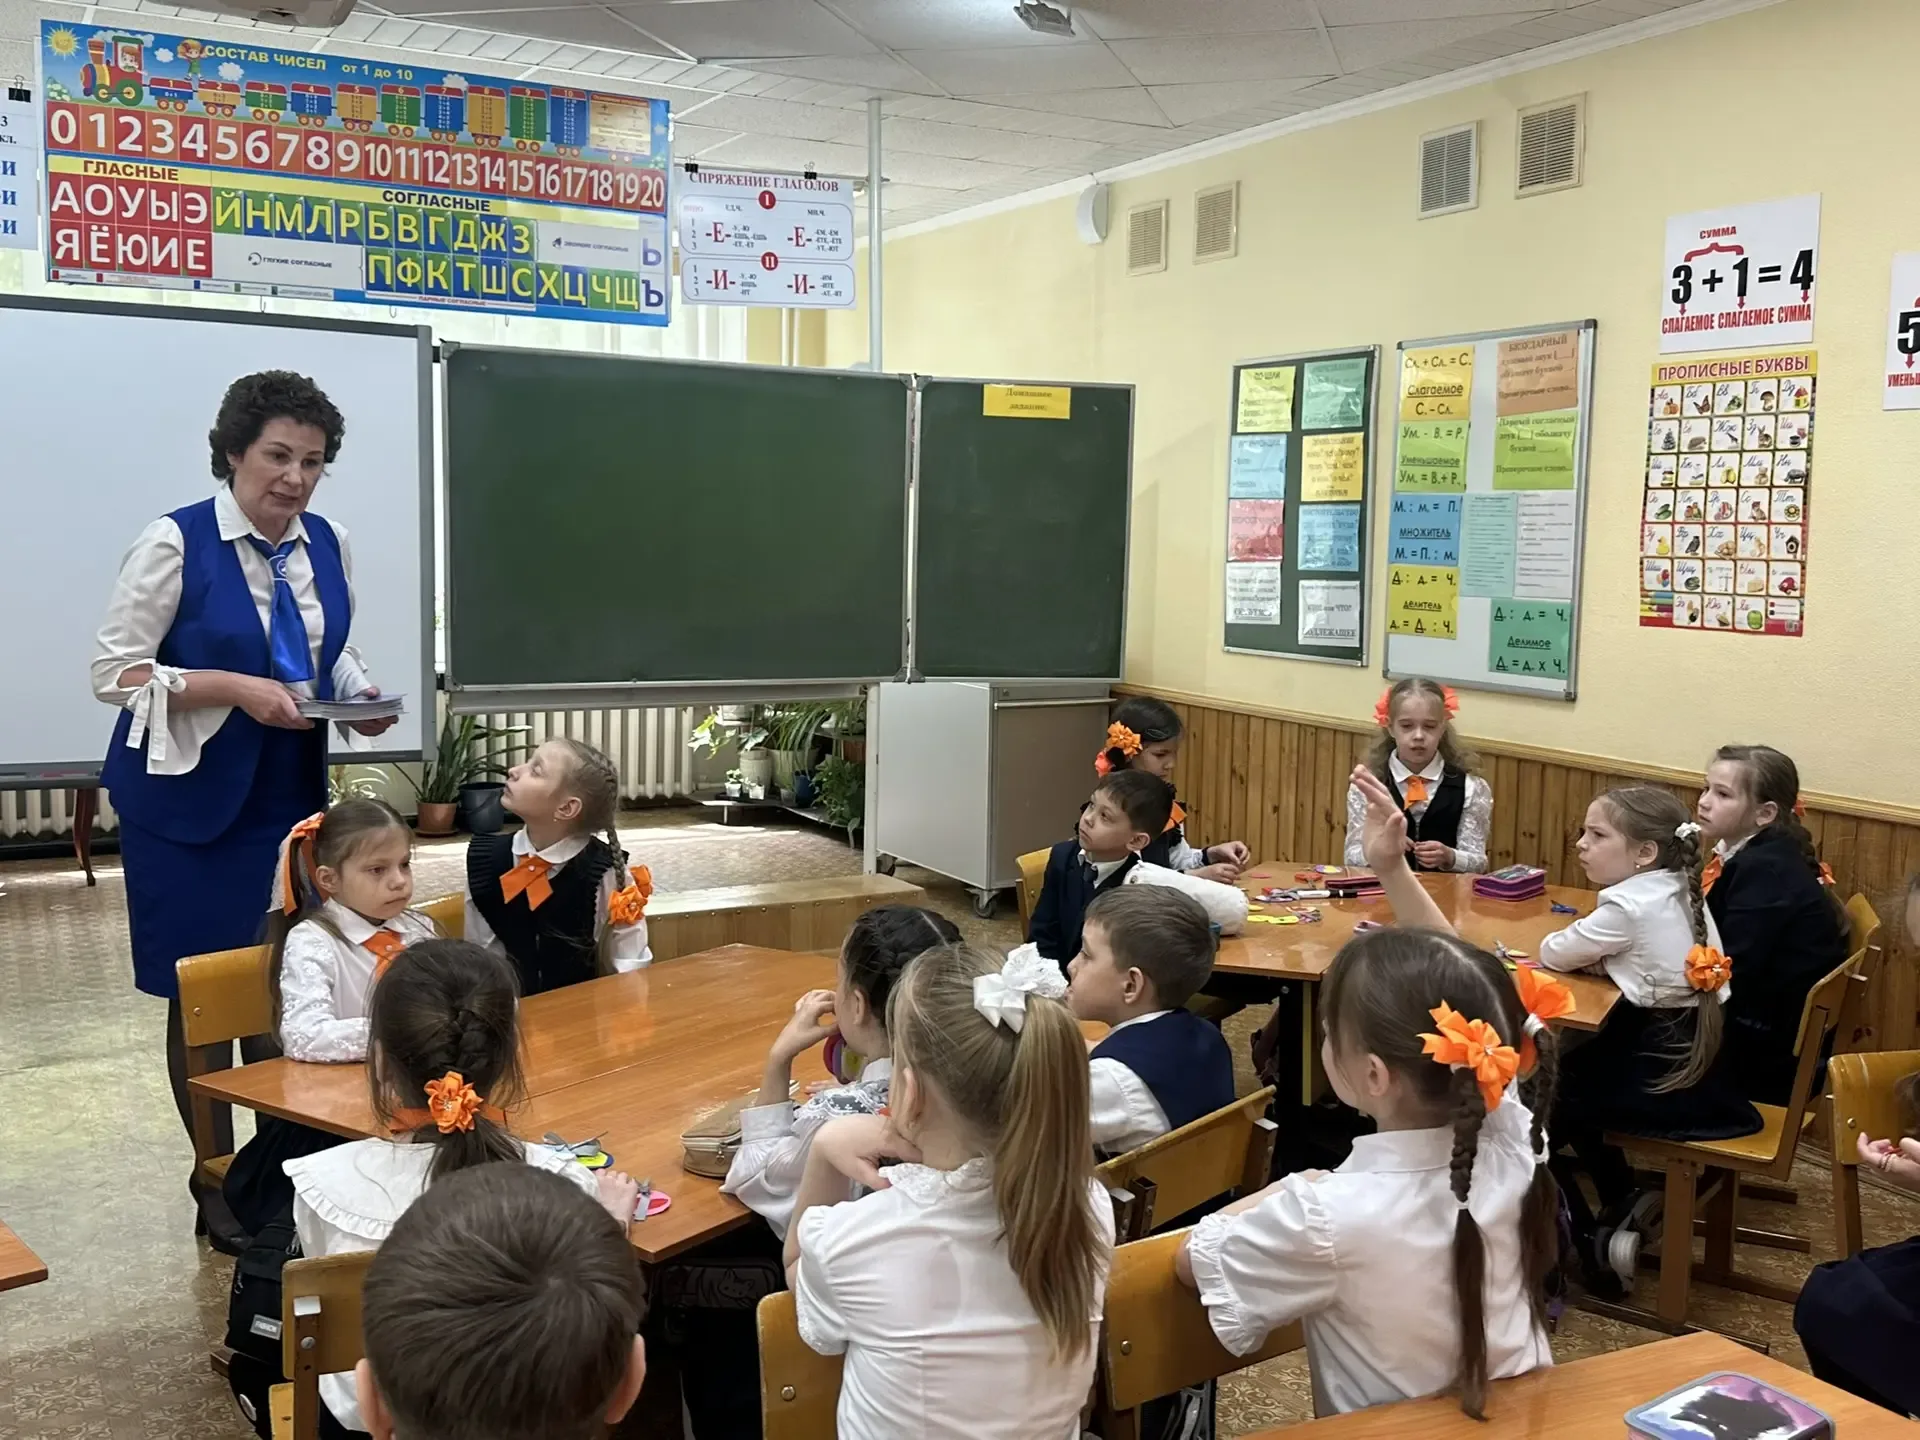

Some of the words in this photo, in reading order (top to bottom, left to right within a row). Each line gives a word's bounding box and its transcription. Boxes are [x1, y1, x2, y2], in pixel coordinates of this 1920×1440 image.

[204, 45, 269, 64] СОСТАВ
[274, 54, 326, 71] ЧИСЕЛ
[341, 65, 357, 74] от
[362, 65, 369, 76] 1
[374, 69, 392, 79] до
[396, 69, 413, 81] 10
[50, 109, 77, 144] 0
[89, 113, 105, 148] 1
[118, 115, 143, 151] 2
[151, 119, 175, 154] 3
[181, 124, 208, 158] 4
[215, 127, 237, 160] 5
[245, 130, 270, 164] 6
[276, 133, 299, 167] 7
[306, 136, 331, 170] 8
[336, 139, 360, 172] 9
[365, 143, 392, 176] 10
[395, 147, 420, 180] 11
[423, 150, 450, 184] 12
[452, 153, 478, 187] 13
[480, 156, 506, 190] 14
[508, 160, 534, 193] 15
[536, 163, 560, 195] 16
[562, 166, 588, 198] 17
[589, 169, 613, 201] 18
[616, 173, 638, 204] 19
[640, 176, 665, 208] 20
[83, 160, 179, 181] ГЛАСНЫЕ
[689, 172, 771, 188] СПРЯЖЕНИЕ
[774, 178, 839, 192] ГЛАГОЛОВ
[382, 190, 491, 212] СОГЛАСНЫЕ
[51, 181, 82, 214] А
[84, 183, 113, 216] О
[117, 186, 145, 218] У
[151, 190, 178, 222] Ы
[184, 192, 207, 224] Э
[215, 191, 241, 228] Й
[245, 199, 270, 231] Н
[275, 205, 301, 233] М
[306, 206, 331, 235] Л
[341, 208, 360, 236] Р
[368, 211, 390, 240] Б
[398, 212, 419, 243] В
[429, 213, 445, 246] Г
[454, 219, 478, 252] Д
[480, 221, 507, 253] Ж
[512, 224, 530, 254] З
[1699, 226, 1737, 239] СУММА
[54, 229, 80, 260] Я
[90, 225, 111, 263] Ё
[117, 235, 147, 266] Ю
[152, 237, 178, 268] И
[186, 240, 207, 270] Е
[642, 238, 662, 266] Ь
[368, 256, 391, 285] П
[397, 257, 422, 287] Ф
[427, 260, 448, 289] К
[456, 262, 476, 291] Т
[482, 263, 506, 295] Ш
[513, 267, 533, 297] С
[538, 271, 559, 299] Х
[563, 273, 587, 305] Ц
[592, 275, 611, 303] Ч
[615, 277, 639, 309] Щ
[1671, 264, 1692, 304] 3
[1702, 269, 1723, 292] +
[1732, 257, 1749, 297] 1
[1758, 265, 1782, 283] =
[1790, 249, 1814, 290] 4
[641, 279, 664, 307] Ъ
[1662, 314, 1715, 334] СЛАГАЕМОЕ
[1718, 307, 1774, 330] СЛАГАЕМОЕ
[1777, 303, 1811, 324] СУММА
[1897, 311, 1920, 354] 5
[1658, 360, 1751, 381] ПРОПИСНЫЕ
[1755, 355, 1809, 374] БУКВЫ
[1408, 384, 1464, 397] Слагаемое
[1507, 636, 1551, 648] Делимое
